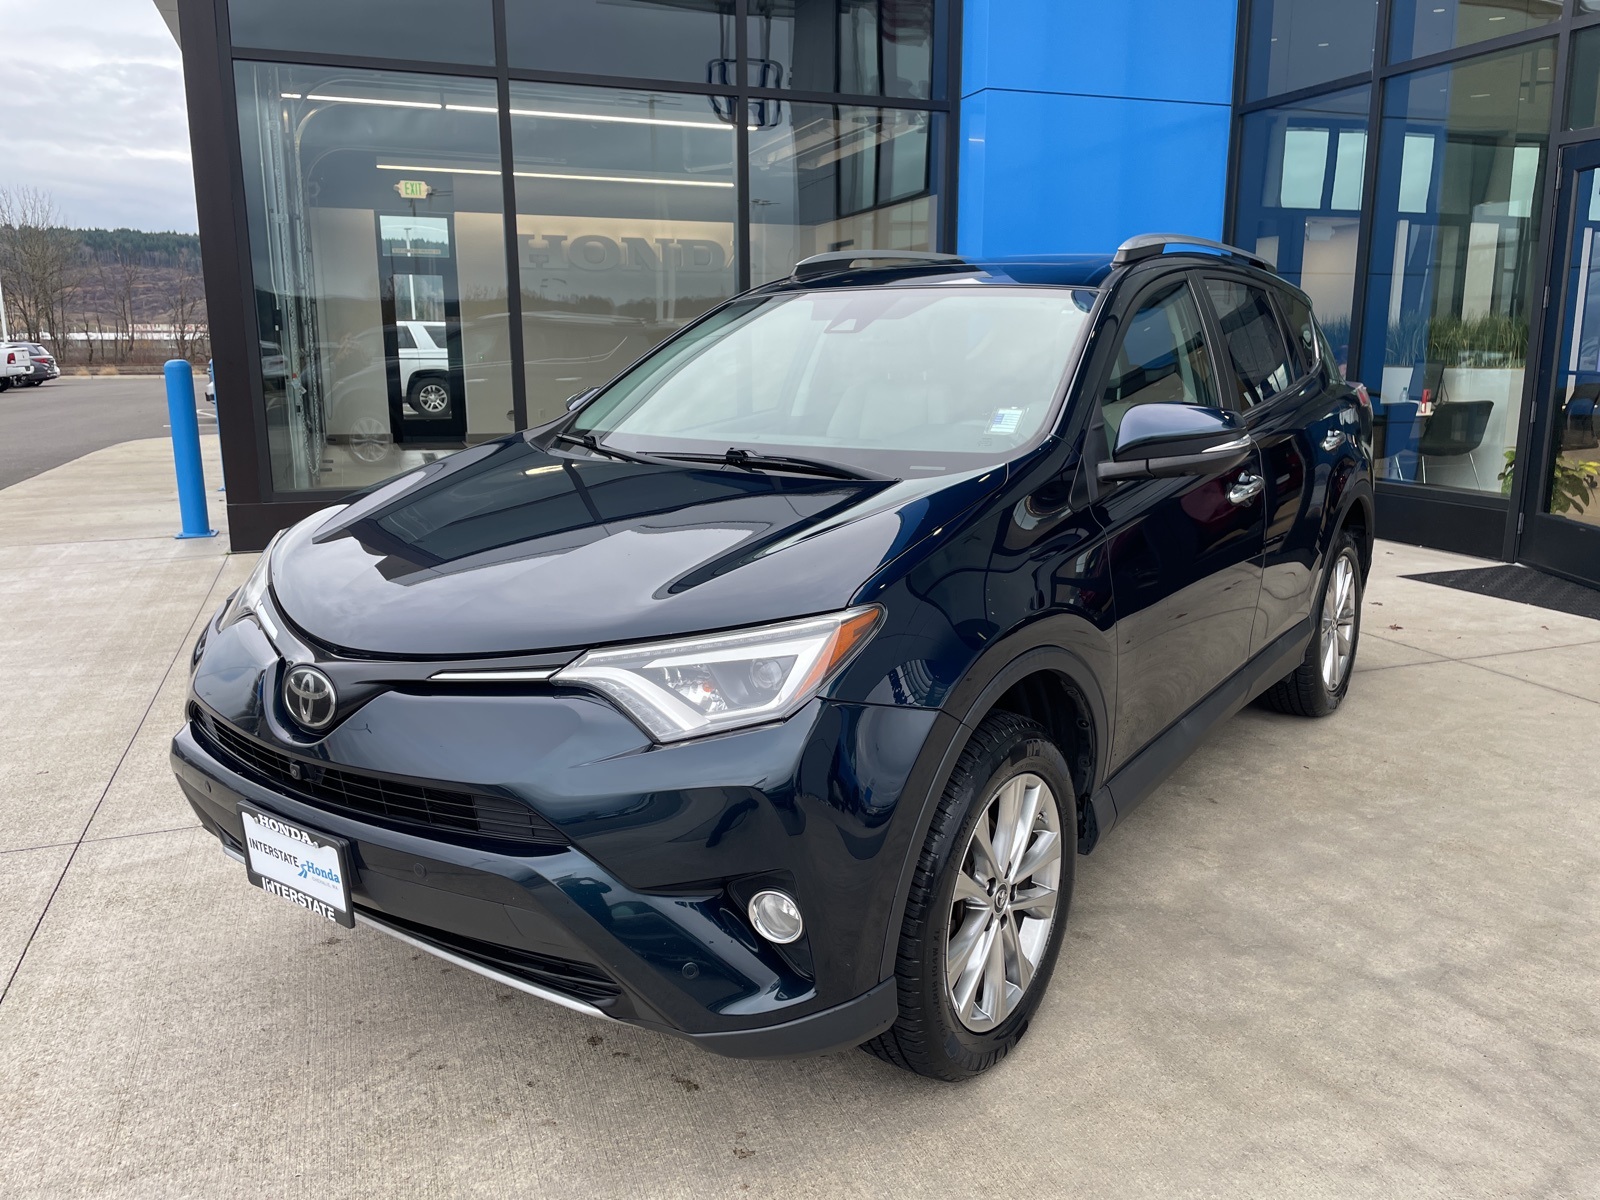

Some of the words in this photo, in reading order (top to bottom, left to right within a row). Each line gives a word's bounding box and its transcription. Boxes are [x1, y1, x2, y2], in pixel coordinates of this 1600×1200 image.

[404, 181, 422, 196] EXIT
[516, 233, 734, 272] HOND
[257, 813, 313, 846] HONDA
[248, 837, 300, 868] INTERSTATE
[305, 860, 340, 884] Honda
[261, 876, 336, 922] INTERSTATE
